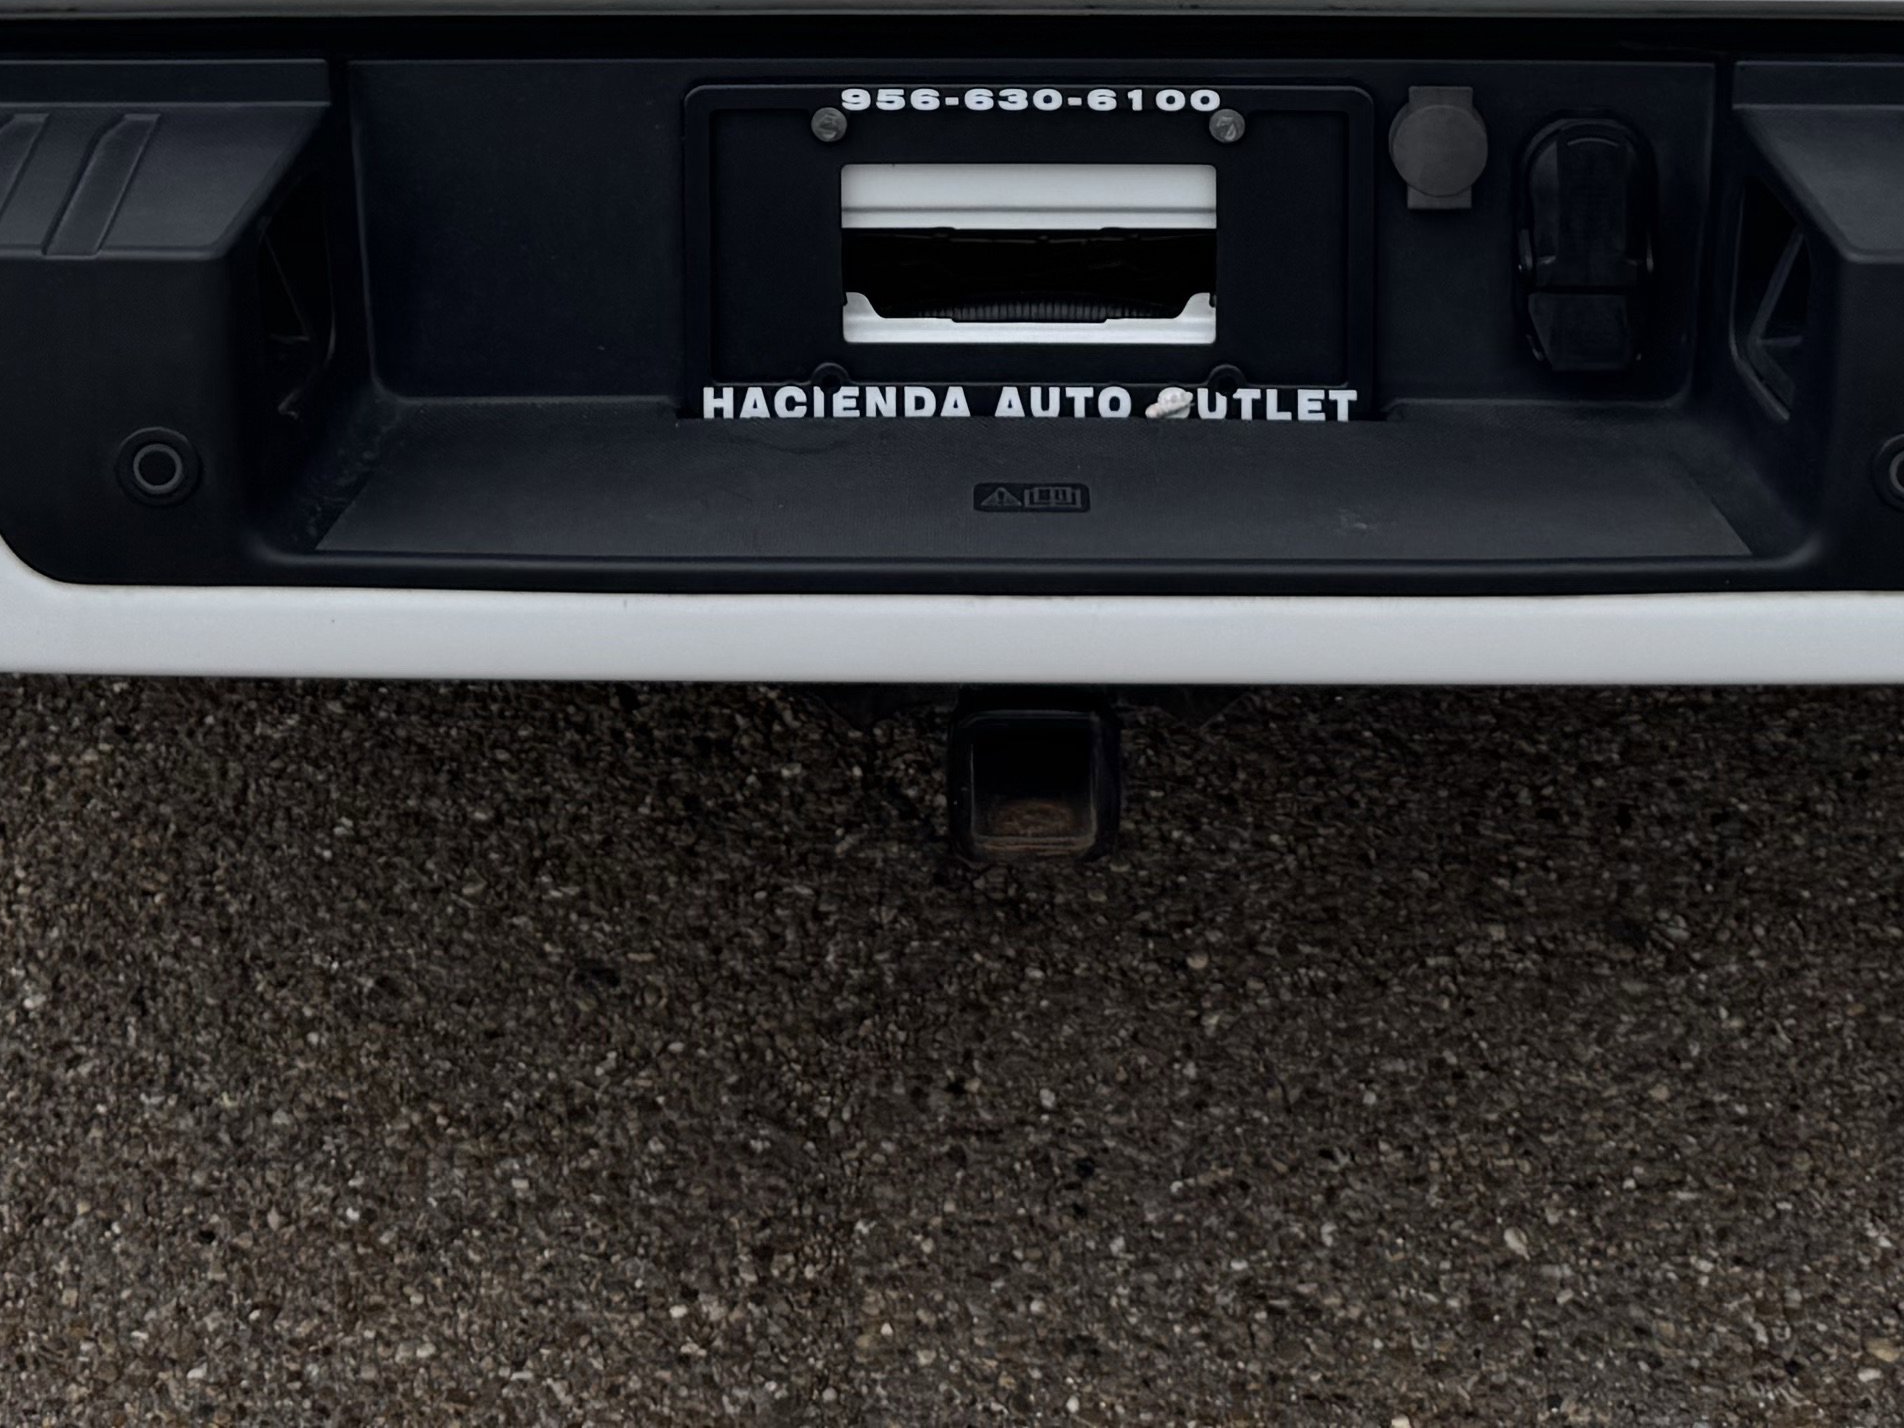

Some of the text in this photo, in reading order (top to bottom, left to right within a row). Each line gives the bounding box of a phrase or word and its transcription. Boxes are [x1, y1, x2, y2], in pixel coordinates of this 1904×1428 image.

[840, 87, 1222, 112] 956-630-6100
[702, 385, 972, 420] HACIENDA
[995, 385, 1132, 419] AUTO
